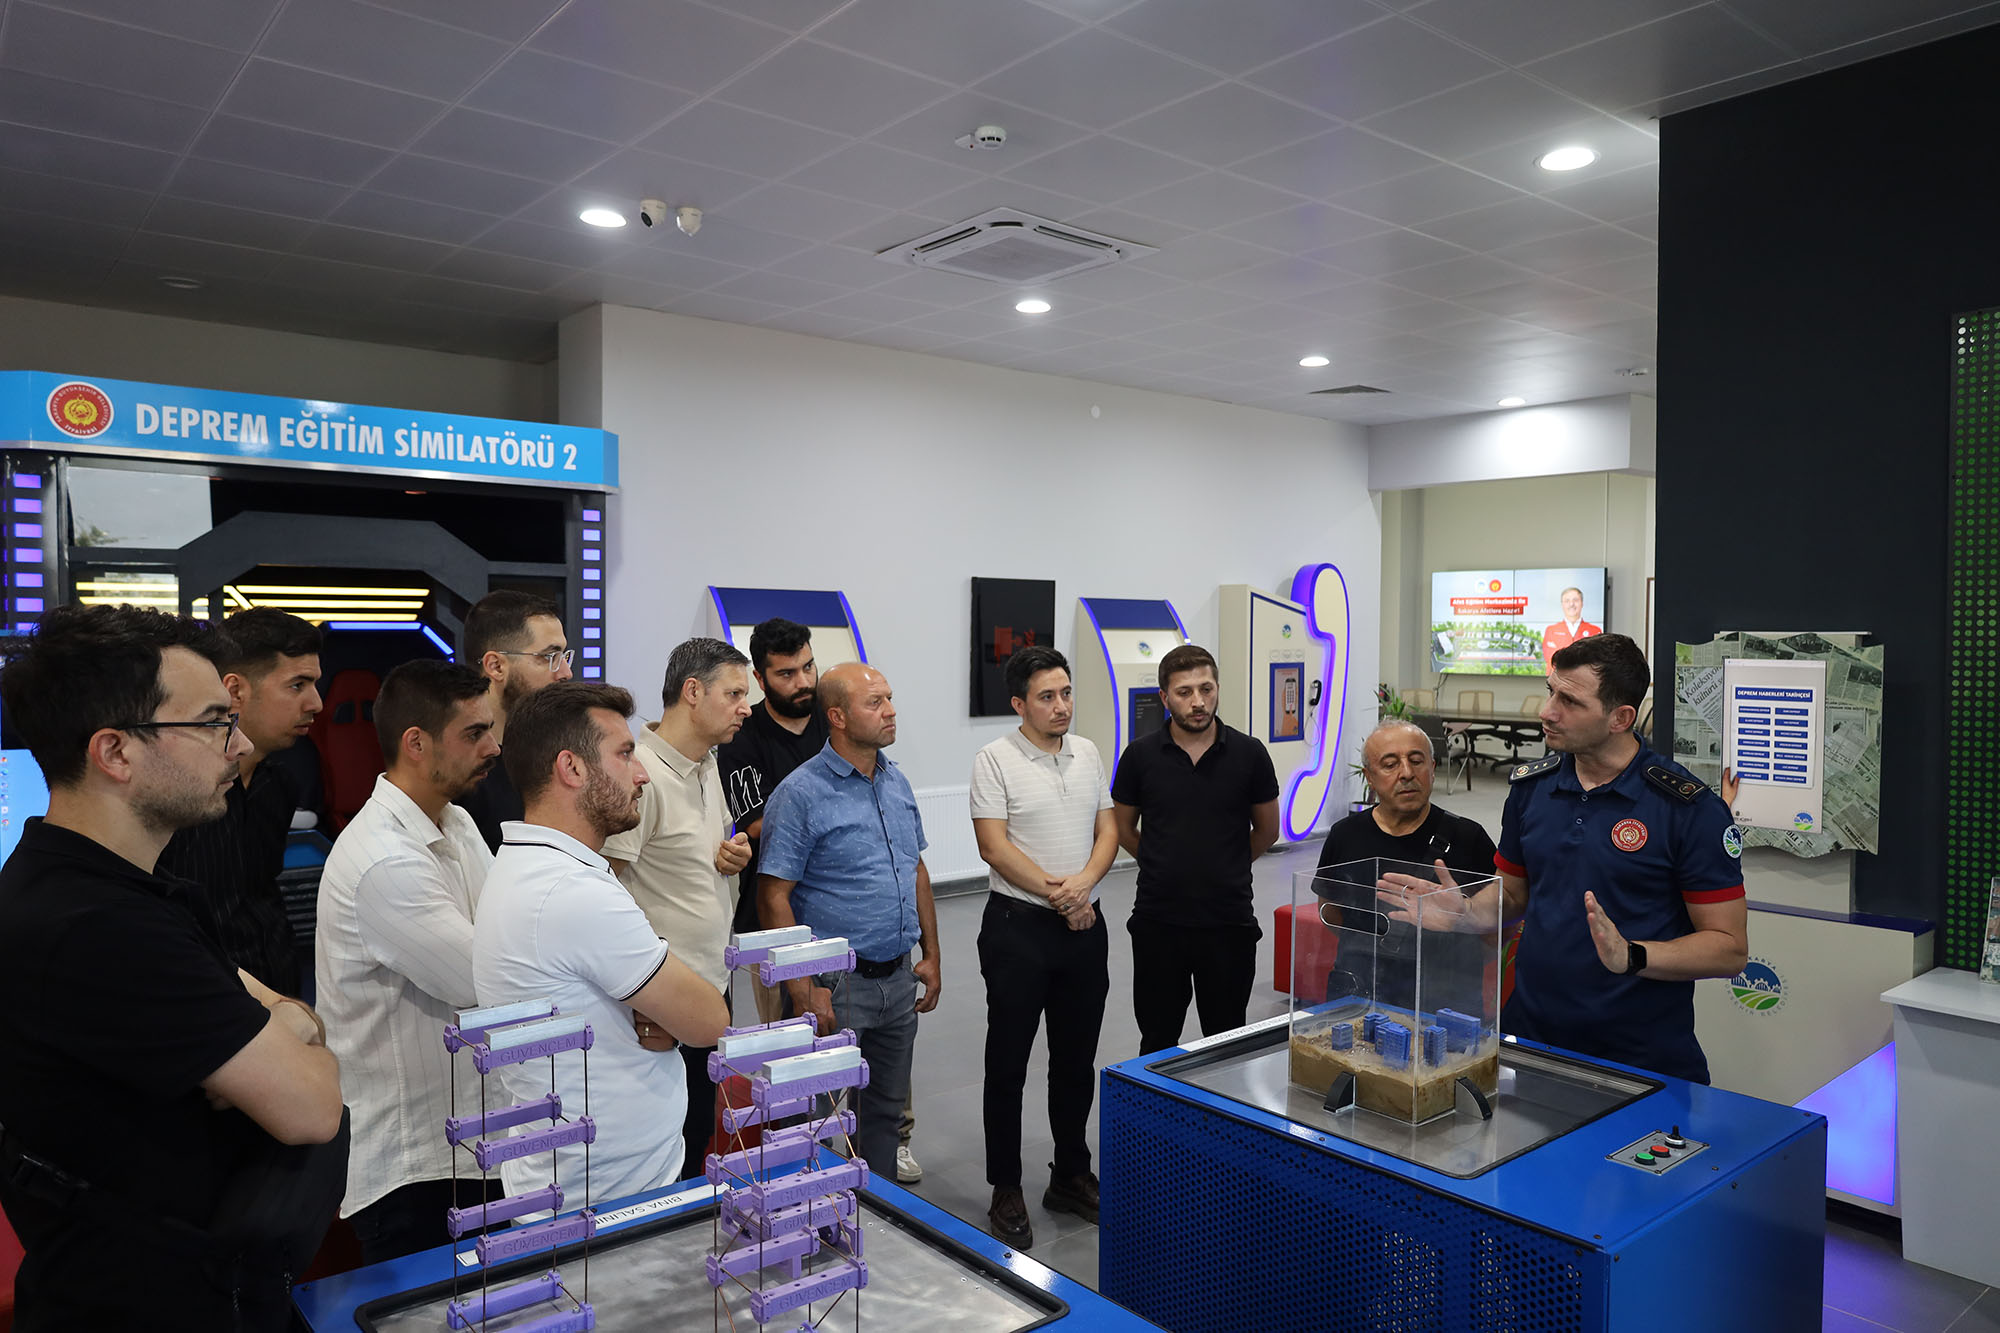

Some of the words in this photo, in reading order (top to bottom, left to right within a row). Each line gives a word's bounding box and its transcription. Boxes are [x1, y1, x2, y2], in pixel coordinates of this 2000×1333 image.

[136, 403, 269, 444] DEPREM
[280, 409, 384, 455] EĞİTİM
[394, 421, 555, 469] SİMİLATÖRÜ
[563, 443, 577, 471] 2
